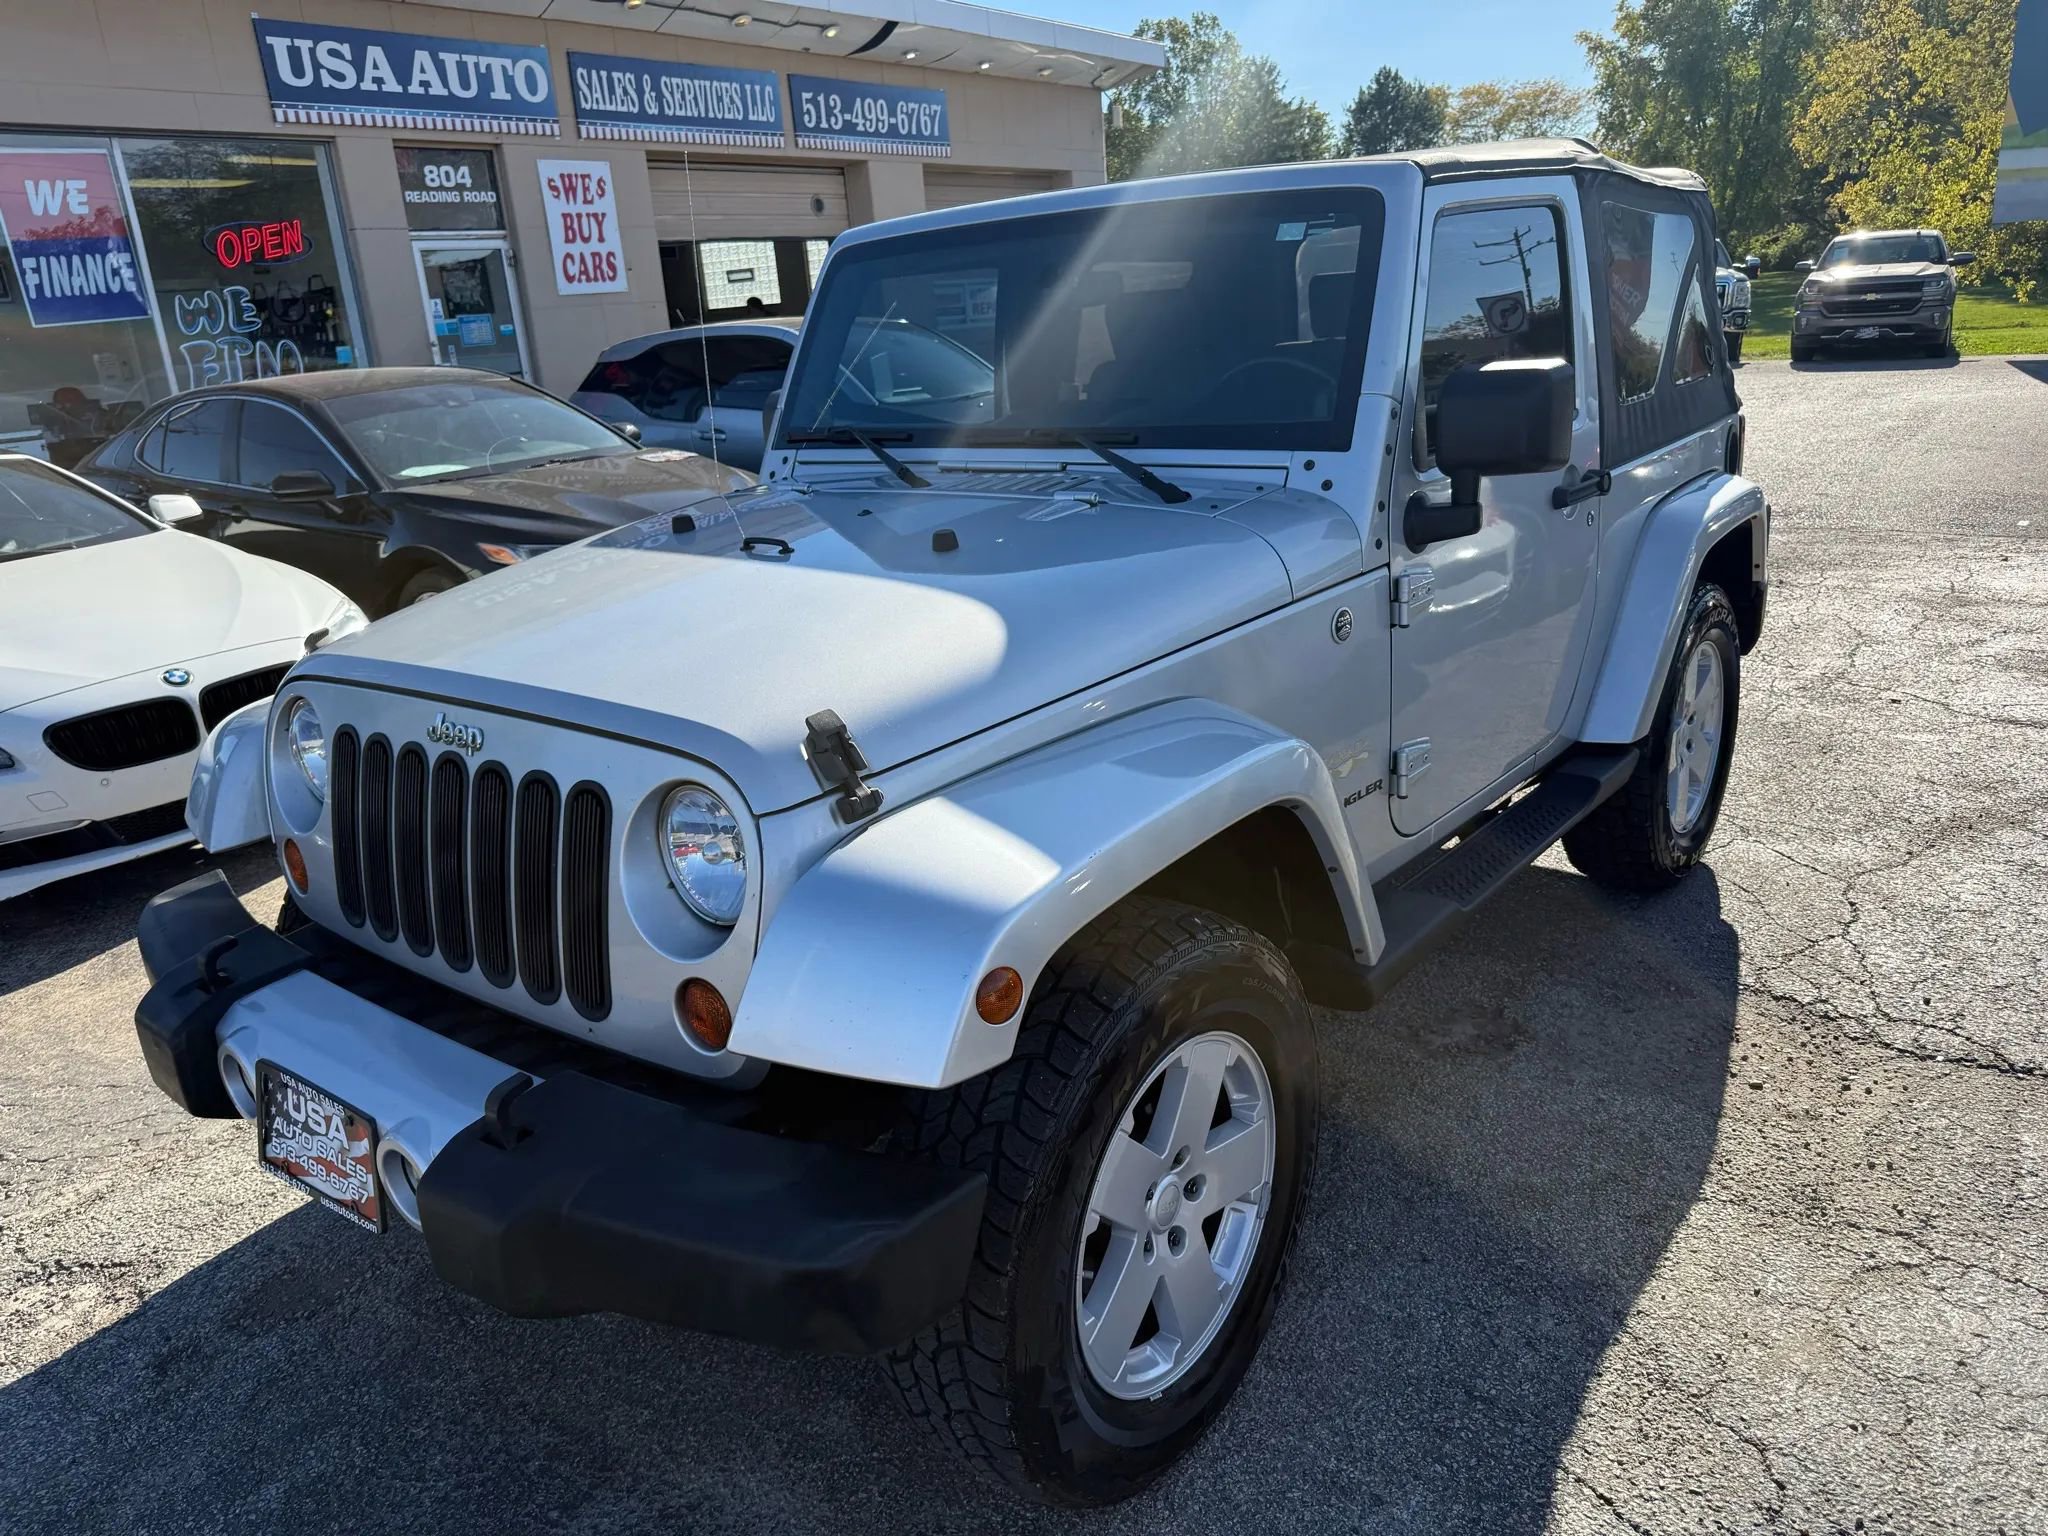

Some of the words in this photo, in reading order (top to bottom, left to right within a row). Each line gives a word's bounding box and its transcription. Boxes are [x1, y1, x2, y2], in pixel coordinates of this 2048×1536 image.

[266, 36, 403, 93] USA
[408, 49, 549, 103] AUTO
[576, 67, 639, 114] SALES
[643, 74, 659, 115] &
[661, 75, 743, 120] SERVICES
[744, 84, 775, 123] LLC
[801, 91, 942, 137] 513-499-6767
[24, 179, 89, 216] WE
[405, 191, 461, 203] READING
[463, 191, 497, 203] ROAD
[423, 165, 472, 188] 804
[216, 219, 303, 268] OPEN
[561, 212, 607, 244] BUY
[22, 252, 137, 299] FINANCE
[562, 251, 618, 284] CARS
[175, 286, 262, 335] WE
[427, 712, 484, 757] Jeep
[280, 1072, 297, 1089] USA
[298, 1082, 318, 1101] AUTO
[320, 1096, 345, 1116] SALES
[287, 1088, 349, 1150] USA
[272, 1116, 312, 1150] AUTO
[317, 1139, 368, 1184] SALES
[261, 1161, 310, 1195] 513-499-6767
[320, 1196, 378, 1234] usaautoss.com
